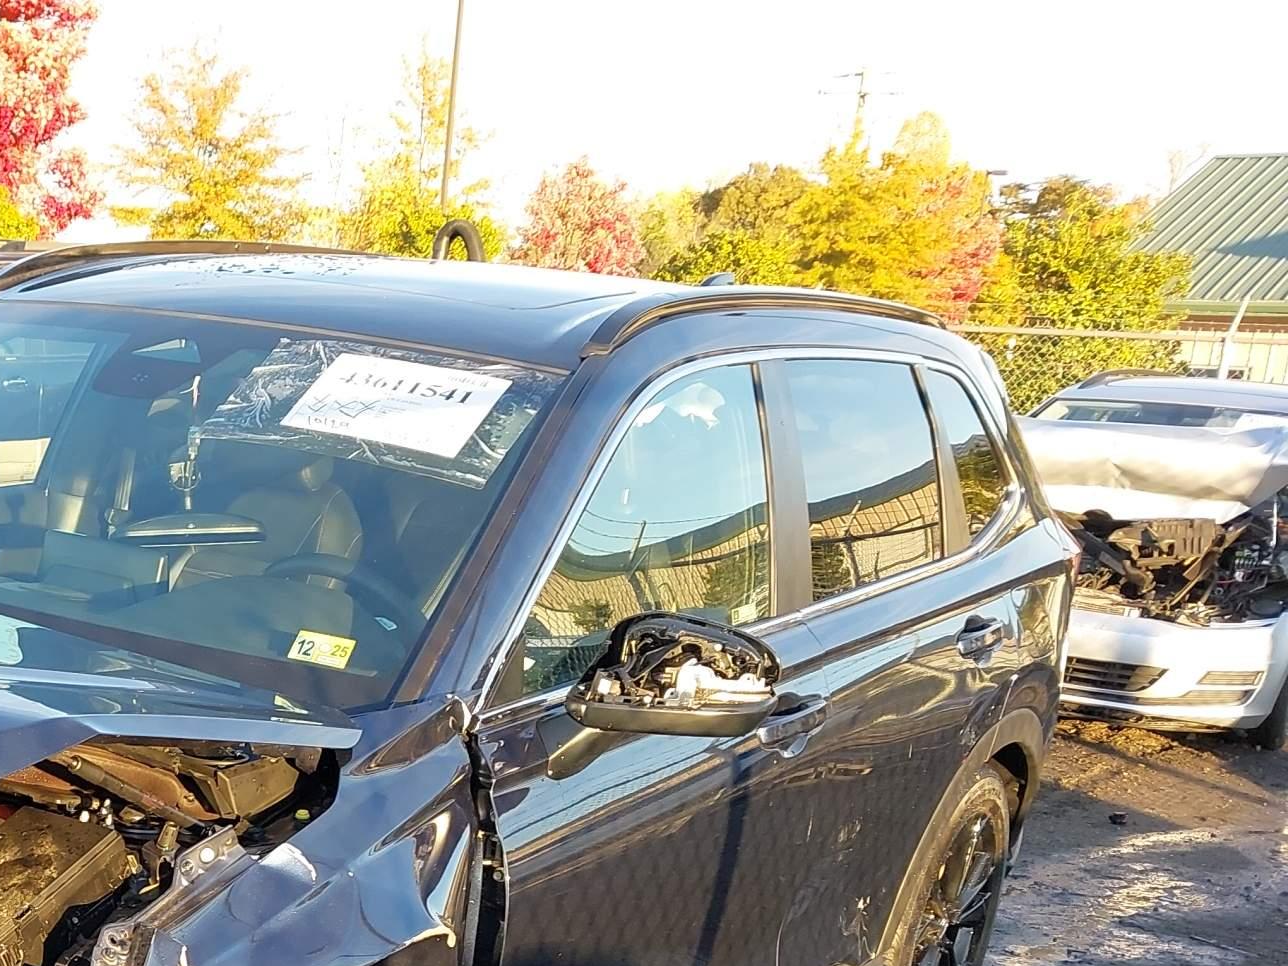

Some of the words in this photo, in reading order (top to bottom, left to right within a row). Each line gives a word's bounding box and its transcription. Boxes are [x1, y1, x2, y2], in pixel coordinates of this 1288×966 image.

[339, 371, 473, 404] 43611541
[297, 639, 315, 657] 12
[331, 644, 351, 658] 25
